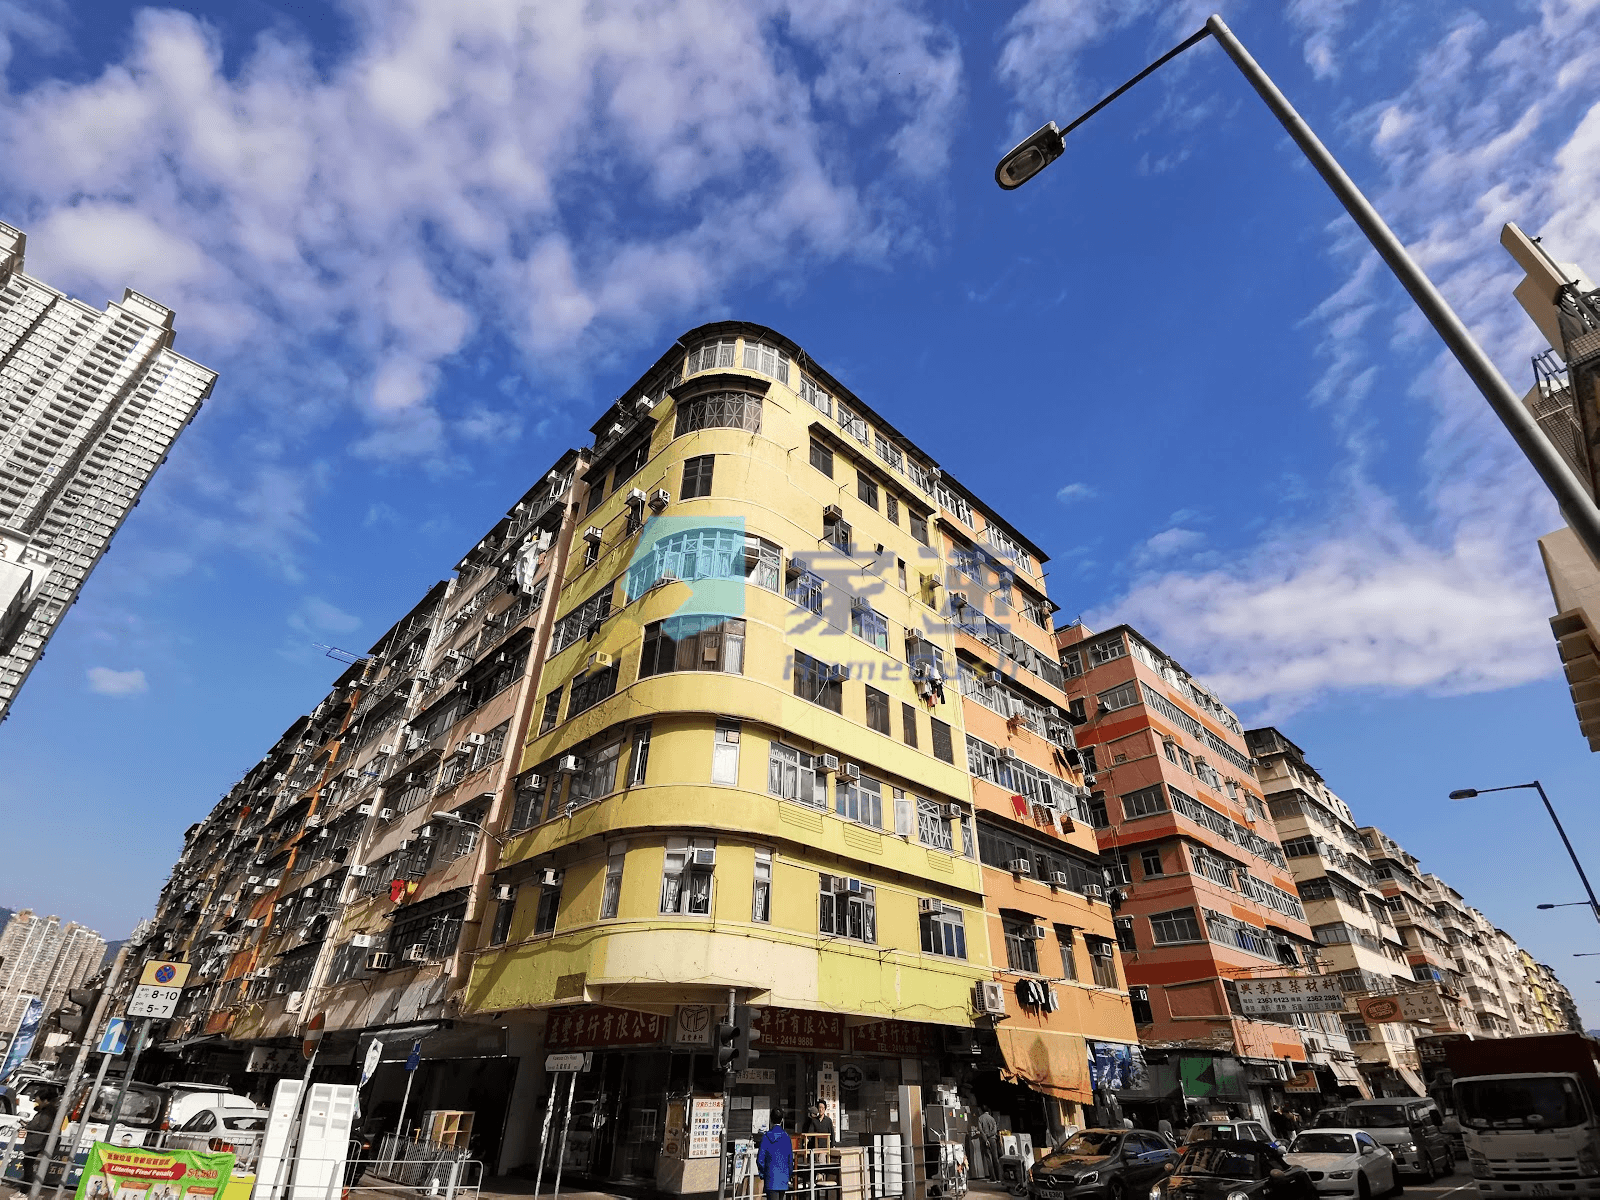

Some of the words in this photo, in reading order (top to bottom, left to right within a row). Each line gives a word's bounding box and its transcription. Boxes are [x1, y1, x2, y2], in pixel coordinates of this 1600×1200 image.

[1240, 978, 1335, 995] 興業建築材料
[152, 990, 178, 1000] 8-10
[750, 1010, 839, 1036] 車行有限公司
[111, 1165, 135, 1175] Littering
